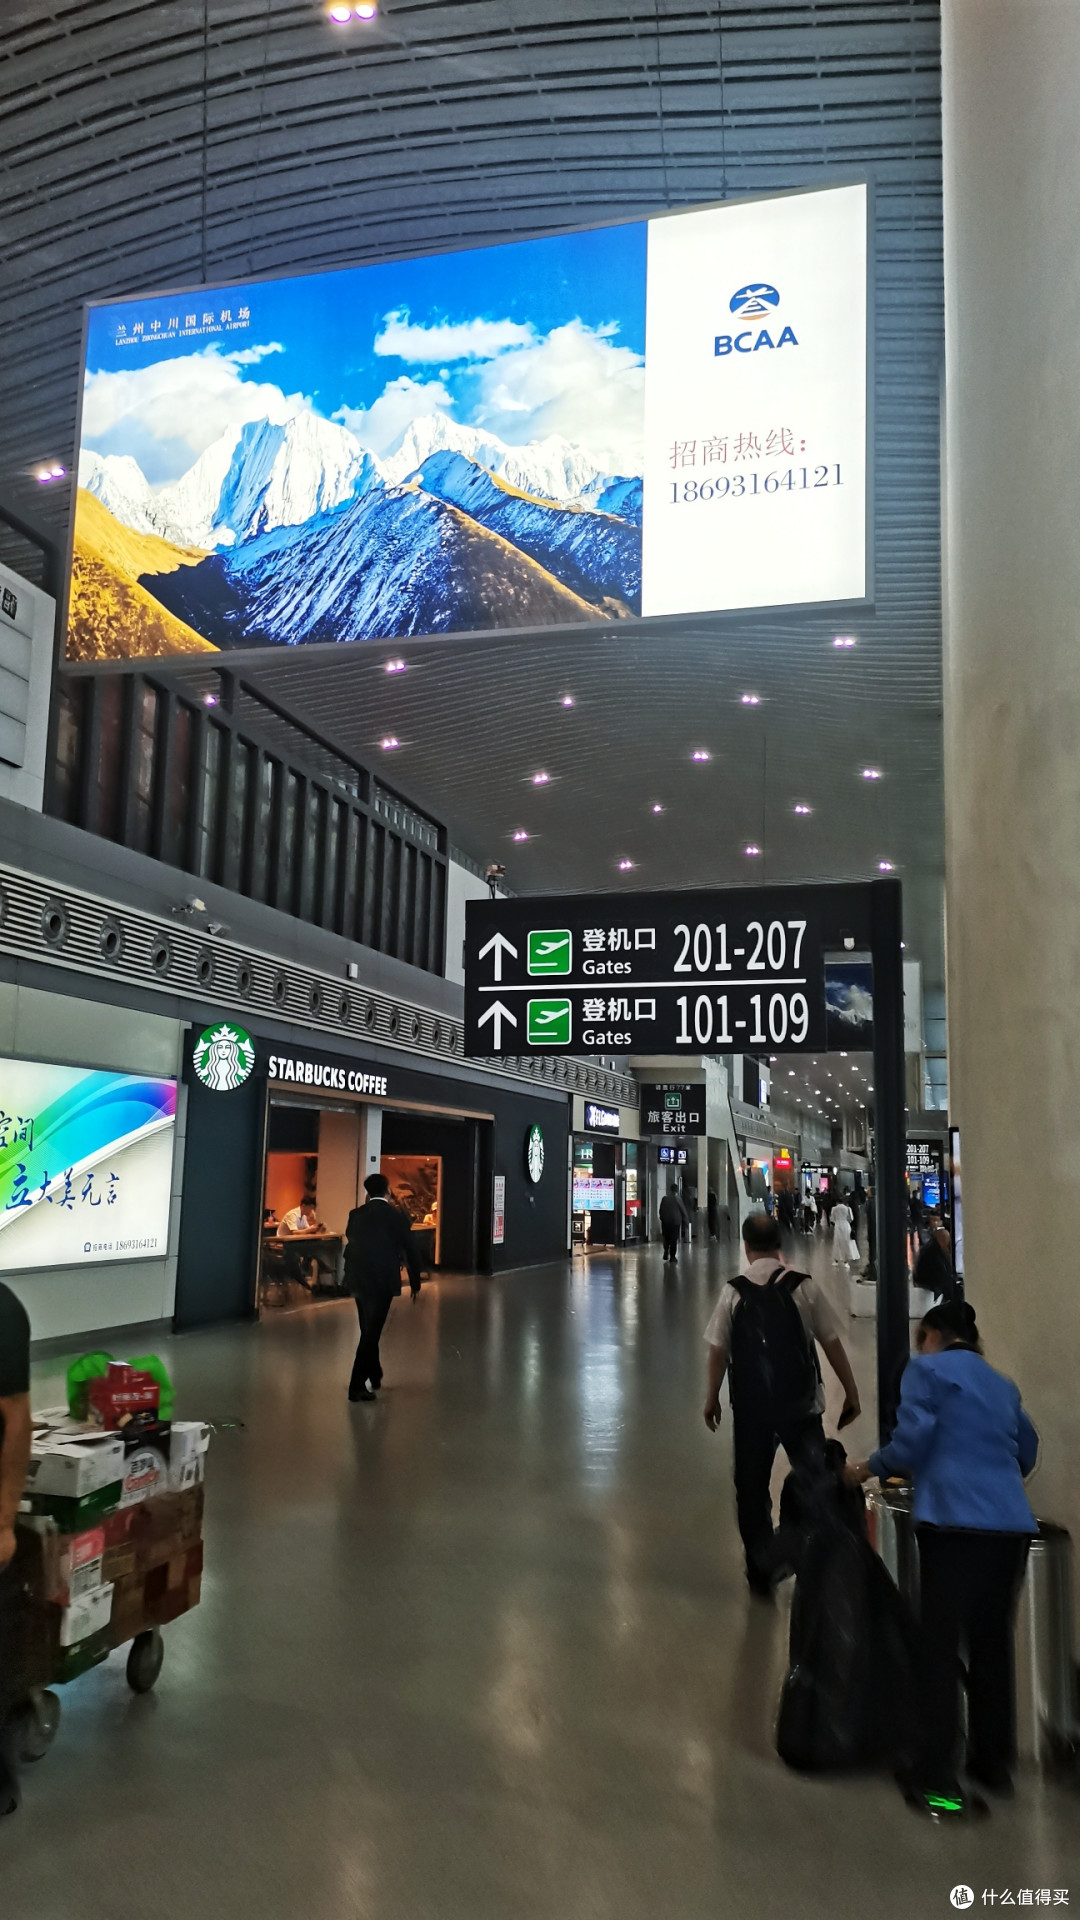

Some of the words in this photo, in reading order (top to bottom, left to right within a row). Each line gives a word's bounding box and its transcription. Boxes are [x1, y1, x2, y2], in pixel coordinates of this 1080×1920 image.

[116, 307, 250, 338] 兰州中川国际机场
[178, 324, 223, 337] INTERNATIONAL
[225, 320, 250, 330] AIRPORT
[714, 326, 799, 357] BCAA
[669, 463, 845, 504] 18693164121
[582, 928, 657, 952] 登机口
[673, 920, 807, 973] 201-207
[582, 959, 632, 975] Gates
[582, 998, 657, 1022] 登机口
[675, 992, 809, 1044] 101-109
[582, 1029, 632, 1046] Gates
[268, 1055, 346, 1089] STARBUCKS
[347, 1070, 388, 1096] COFFEE
[647, 1110, 700, 1123] 旅客出口
[662, 1123, 686, 1133] Exit
[906, 1144, 929, 1153] 201-207
[907, 1155, 930, 1165] 101-109
